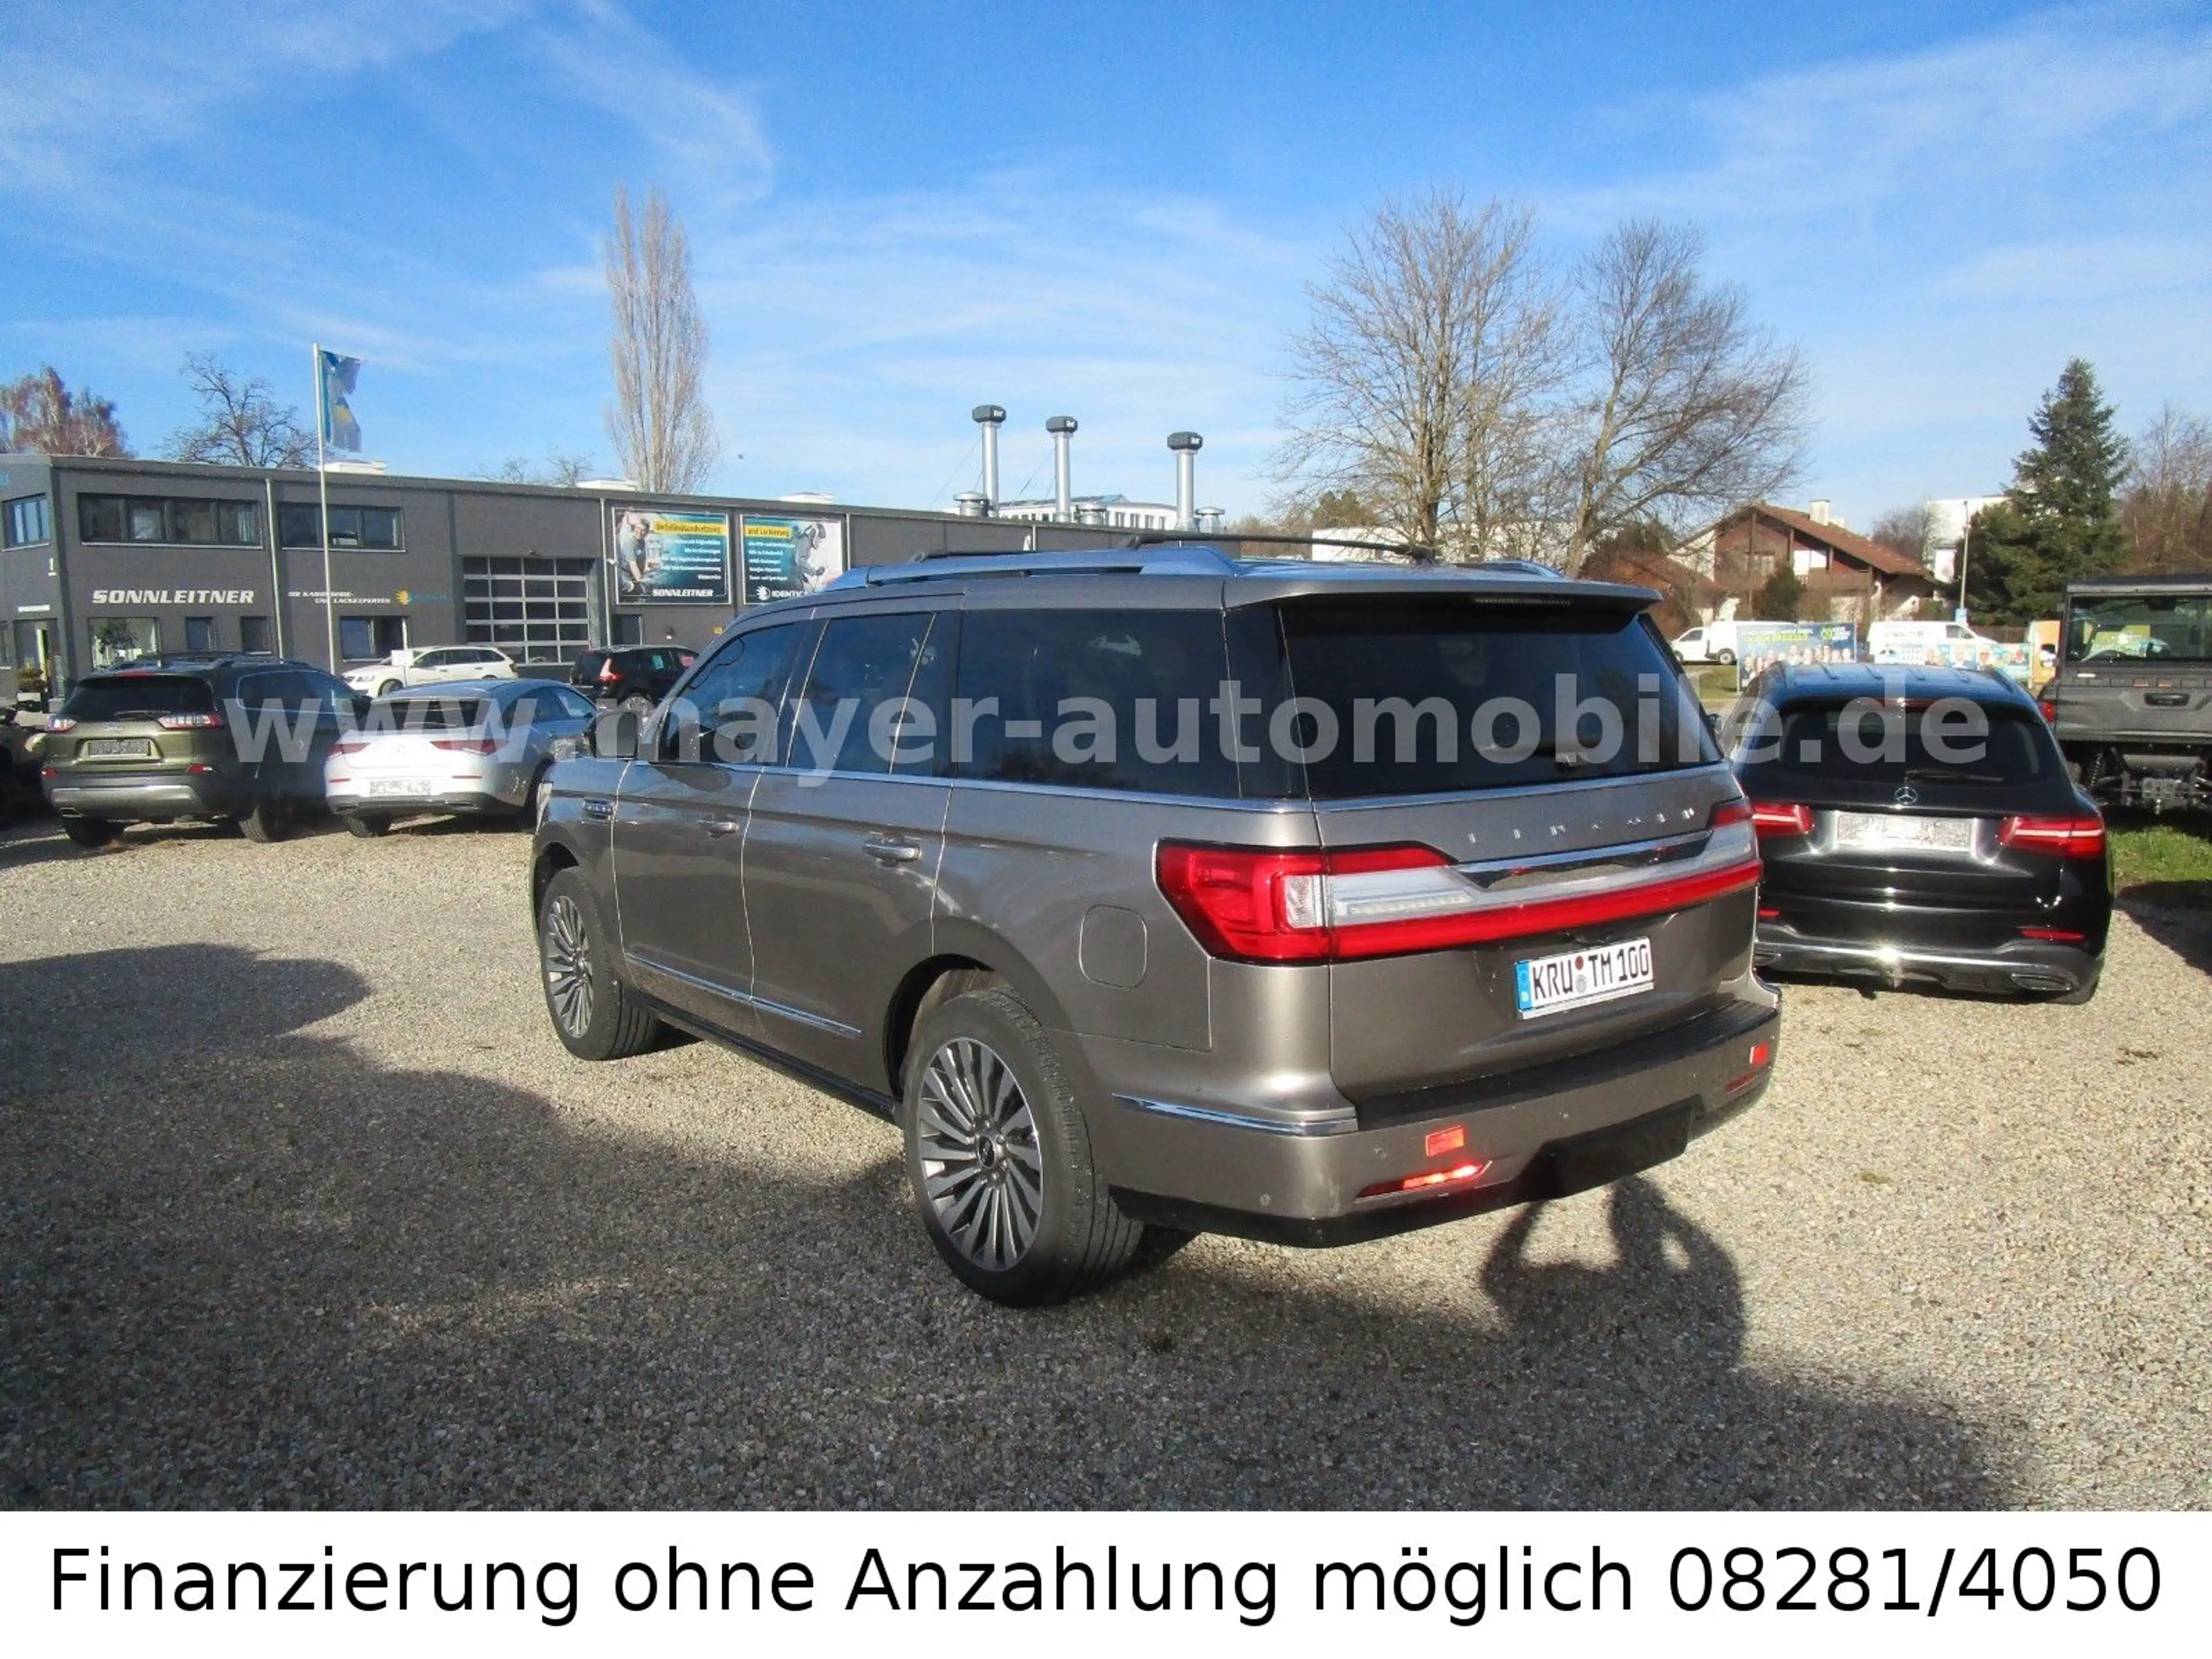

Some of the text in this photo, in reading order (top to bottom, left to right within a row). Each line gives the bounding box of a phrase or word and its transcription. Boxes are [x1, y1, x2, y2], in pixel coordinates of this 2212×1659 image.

[92, 590, 254, 604] SONNLEITNER
[652, 588, 714, 597] SONNLEITNER
[1532, 960, 1573, 1001] KRU
